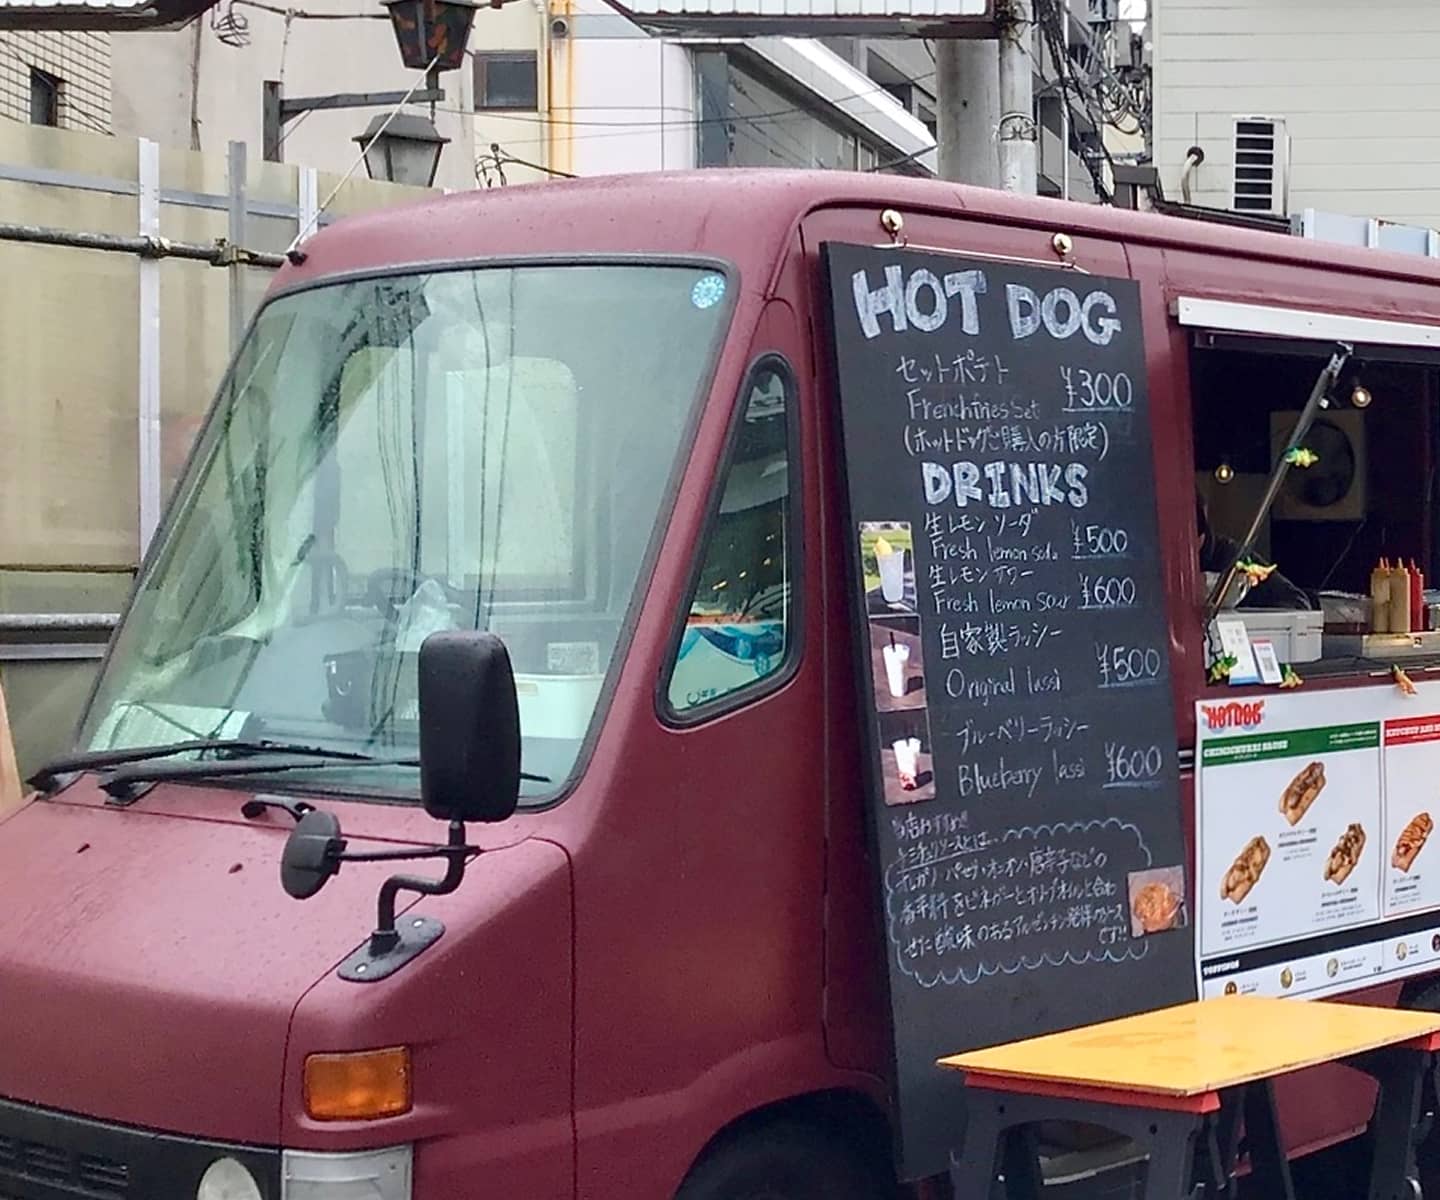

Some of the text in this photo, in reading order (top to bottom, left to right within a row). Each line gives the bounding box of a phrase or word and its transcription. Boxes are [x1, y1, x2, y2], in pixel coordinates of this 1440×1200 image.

[852, 265, 1122, 345] HOT DOG
[896, 349, 1009, 385] セットポテト
[1060, 366, 1134, 409] ¥300
[922, 462, 1088, 508] DRINKS
[924, 508, 1040, 538] 生レモンソーダ
[1071, 517, 1129, 554] ¥500
[932, 536, 978, 561] Fresh
[987, 535, 1028, 562] lemon
[933, 589, 979, 614] Fresh
[990, 588, 1031, 614] lemon
[1078, 573, 1137, 608] ¥600
[940, 621, 1063, 660] 自家製ラッシー
[1096, 644, 1160, 685] ¥500
[946, 668, 1062, 706] Original lassi
[956, 715, 1089, 756] ブルーベリーラッシー
[958, 748, 1086, 799] Blueberry lassi
[1104, 742, 1163, 782] ¥600
